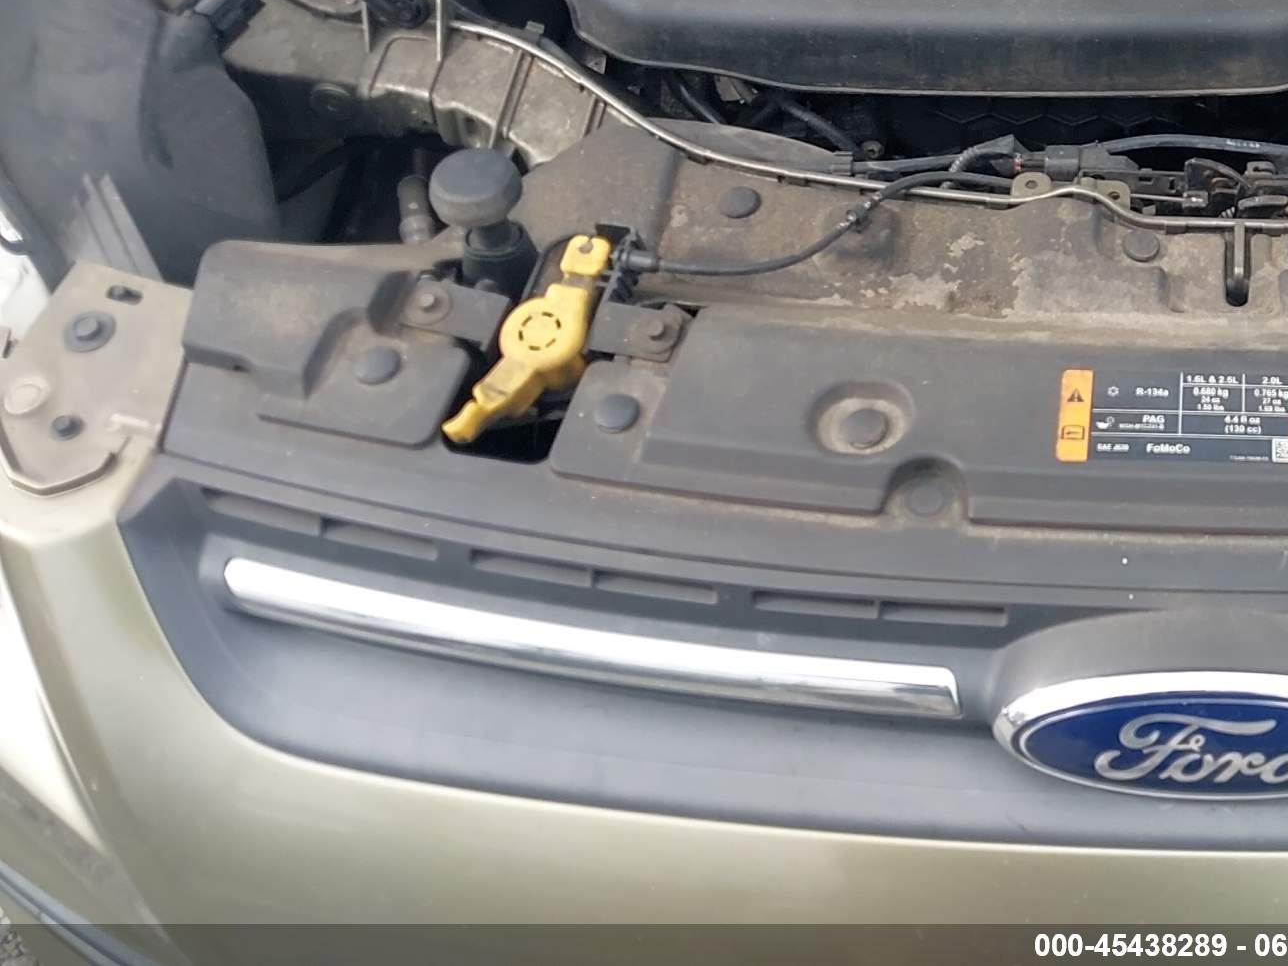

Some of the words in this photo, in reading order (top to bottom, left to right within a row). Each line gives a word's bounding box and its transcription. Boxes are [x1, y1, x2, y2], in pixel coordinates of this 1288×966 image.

[1262, 376, 1283, 385] 2.0L
[1136, 387, 1169, 397] R-134a
[1217, 387, 1229, 400] kg
[1142, 415, 1165, 424] PAG
[1146, 443, 1191, 455] FoMoCo
